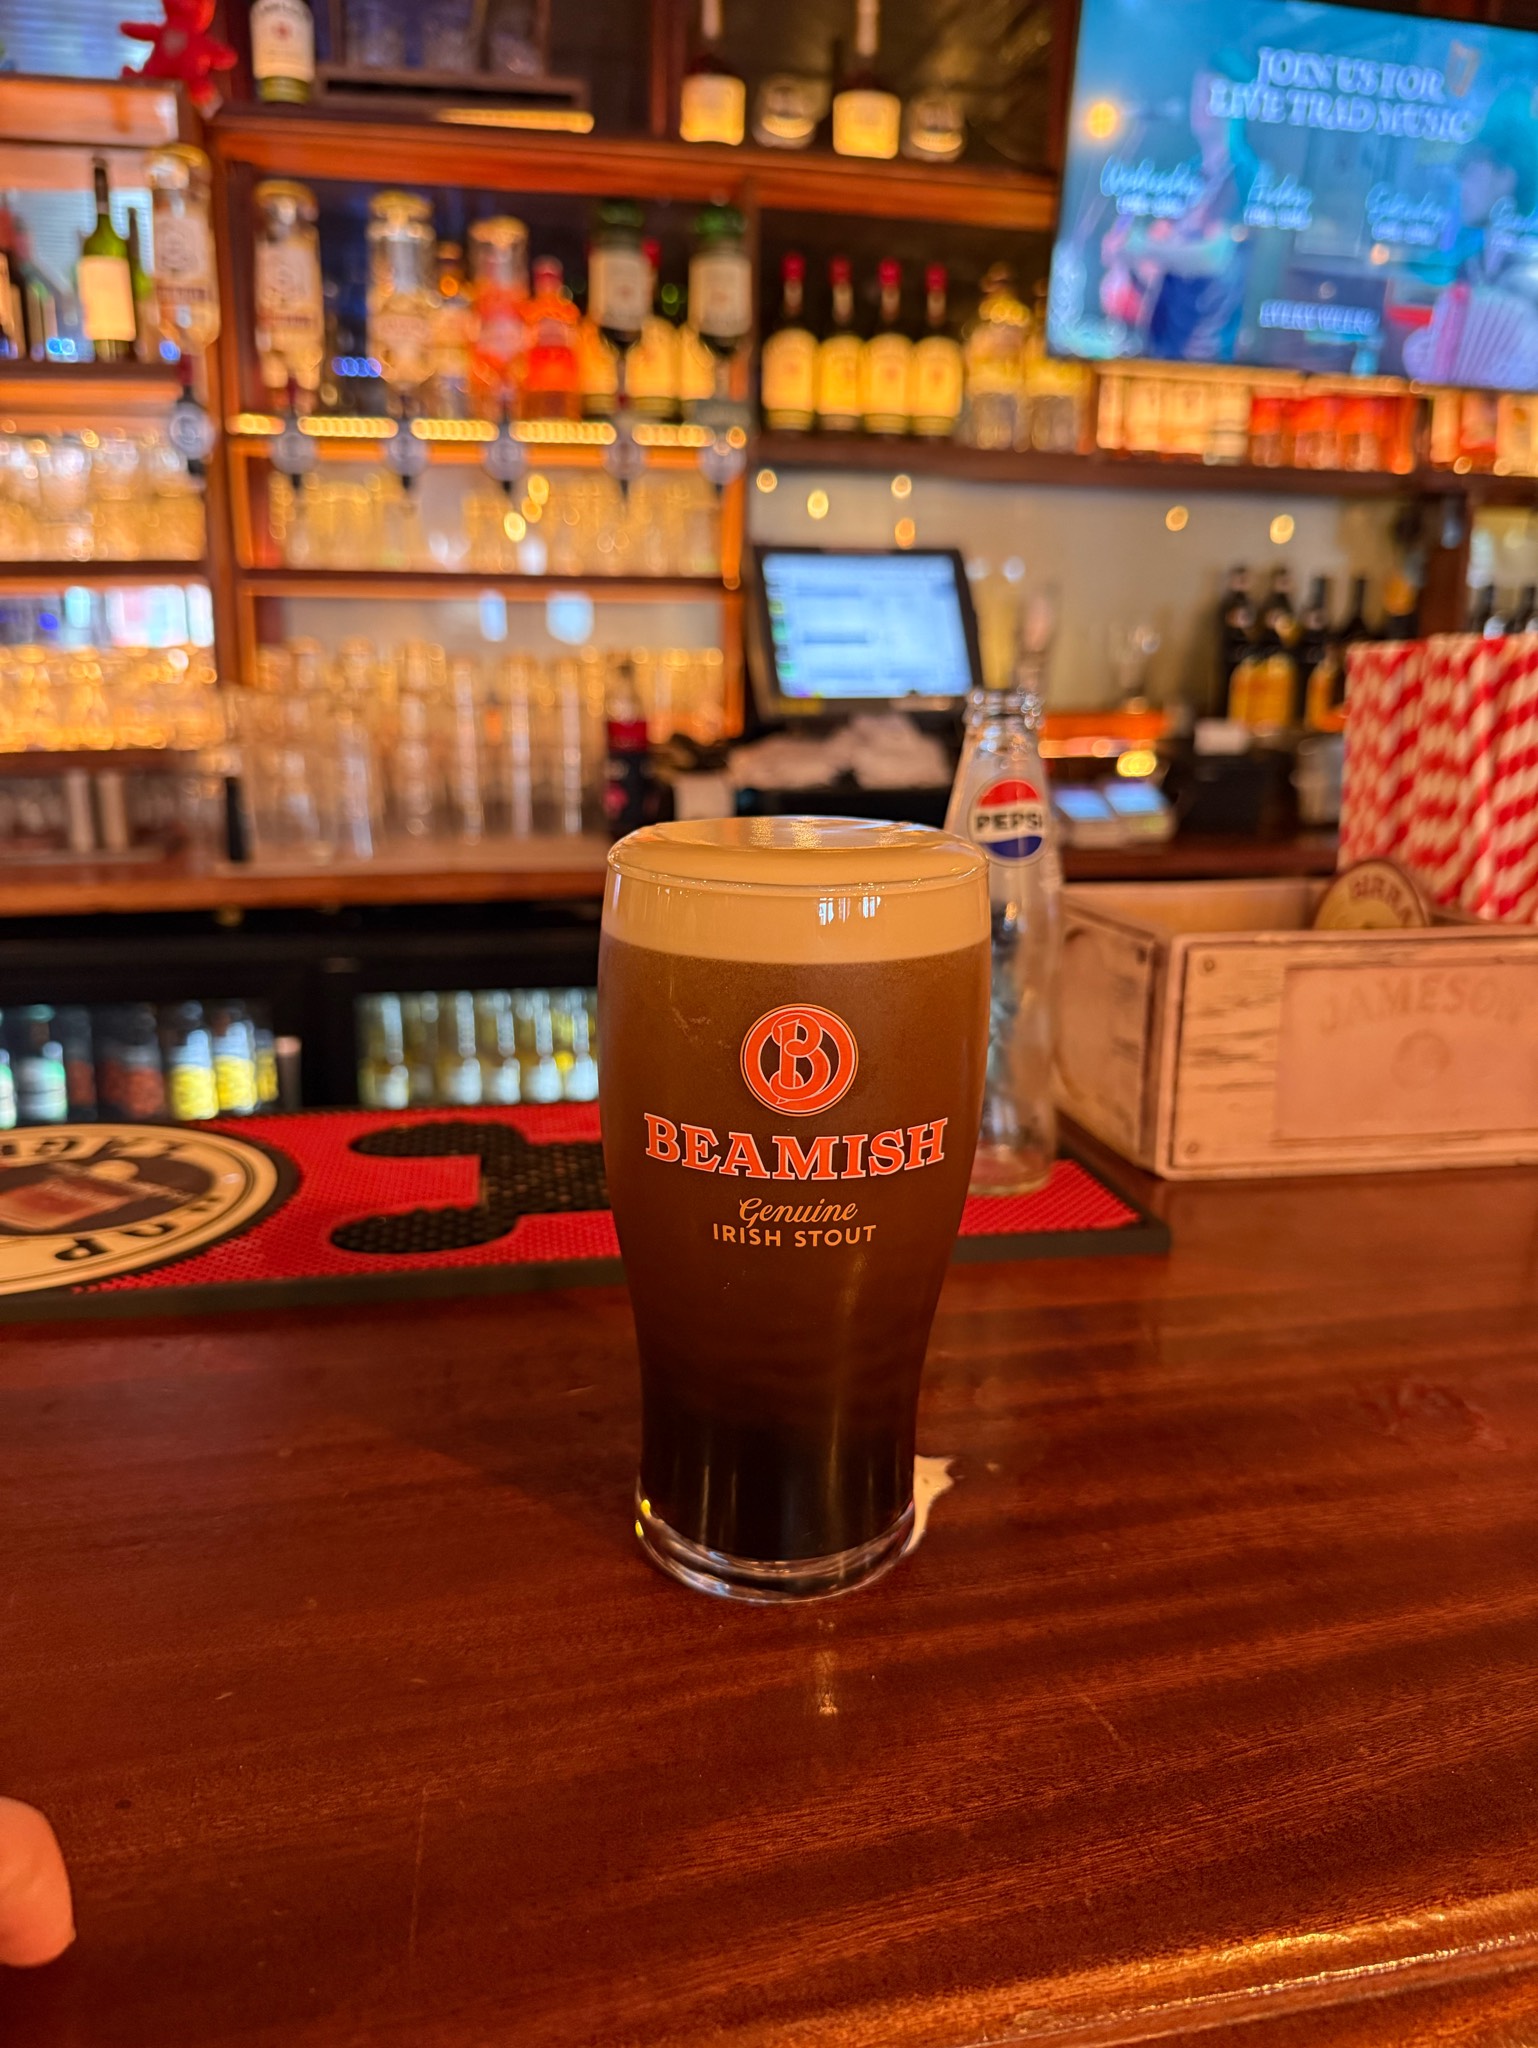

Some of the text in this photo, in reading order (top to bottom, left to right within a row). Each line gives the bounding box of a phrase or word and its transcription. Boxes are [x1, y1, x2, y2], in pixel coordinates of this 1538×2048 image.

[1337, 57, 1378, 96] US
[1210, 79, 1476, 143] LIVE TRAD MUSIC
[976, 811, 1042, 832] PEPSI
[643, 1112, 948, 1181] BEAMISH
[739, 1197, 858, 1228] Genuine
[713, 1223, 876, 1247] IRISH STOUT
